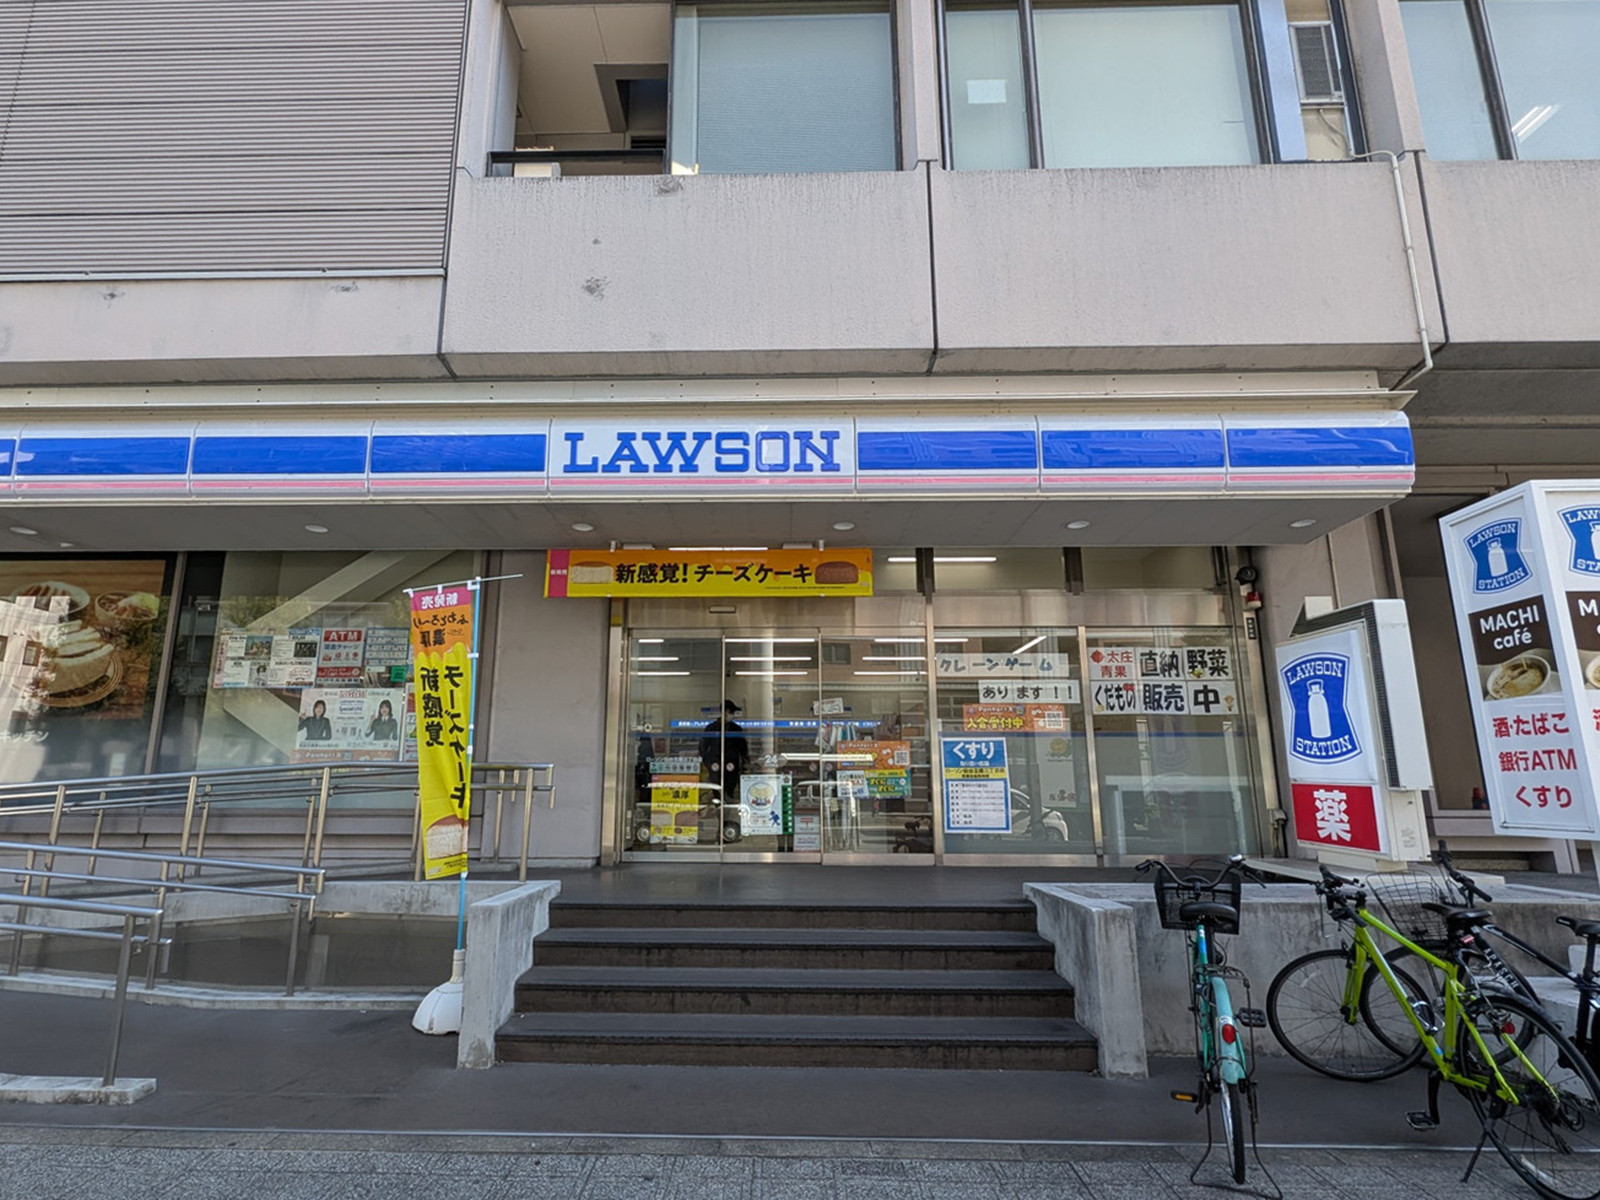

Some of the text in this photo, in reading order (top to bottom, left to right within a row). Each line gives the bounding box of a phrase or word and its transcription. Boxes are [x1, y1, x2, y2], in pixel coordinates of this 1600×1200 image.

[563, 431, 840, 473] LAWSON
[1565, 510, 1600, 523] LAW
[1469, 522, 1516, 547] LAWSON
[615, 562, 813, 584] 新感覚!チーズケーキ
[1478, 567, 1525, 590] STATION
[1480, 604, 1540, 634] MACHI
[329, 631, 358, 641] ATM
[1494, 627, 1533, 651] café
[940, 656, 1053, 673] クレーンゲーム
[1101, 665, 1127, 678] 青果
[1286, 660, 1343, 685] LAWSON
[967, 716, 1024, 729] 入会受付中
[953, 742, 995, 759] くすり
[1296, 735, 1351, 757] STATION
[1499, 749, 1578, 773] 銀行ATM
[1515, 786, 1572, 808] くすり
[1313, 789, 1352, 842] 薬
